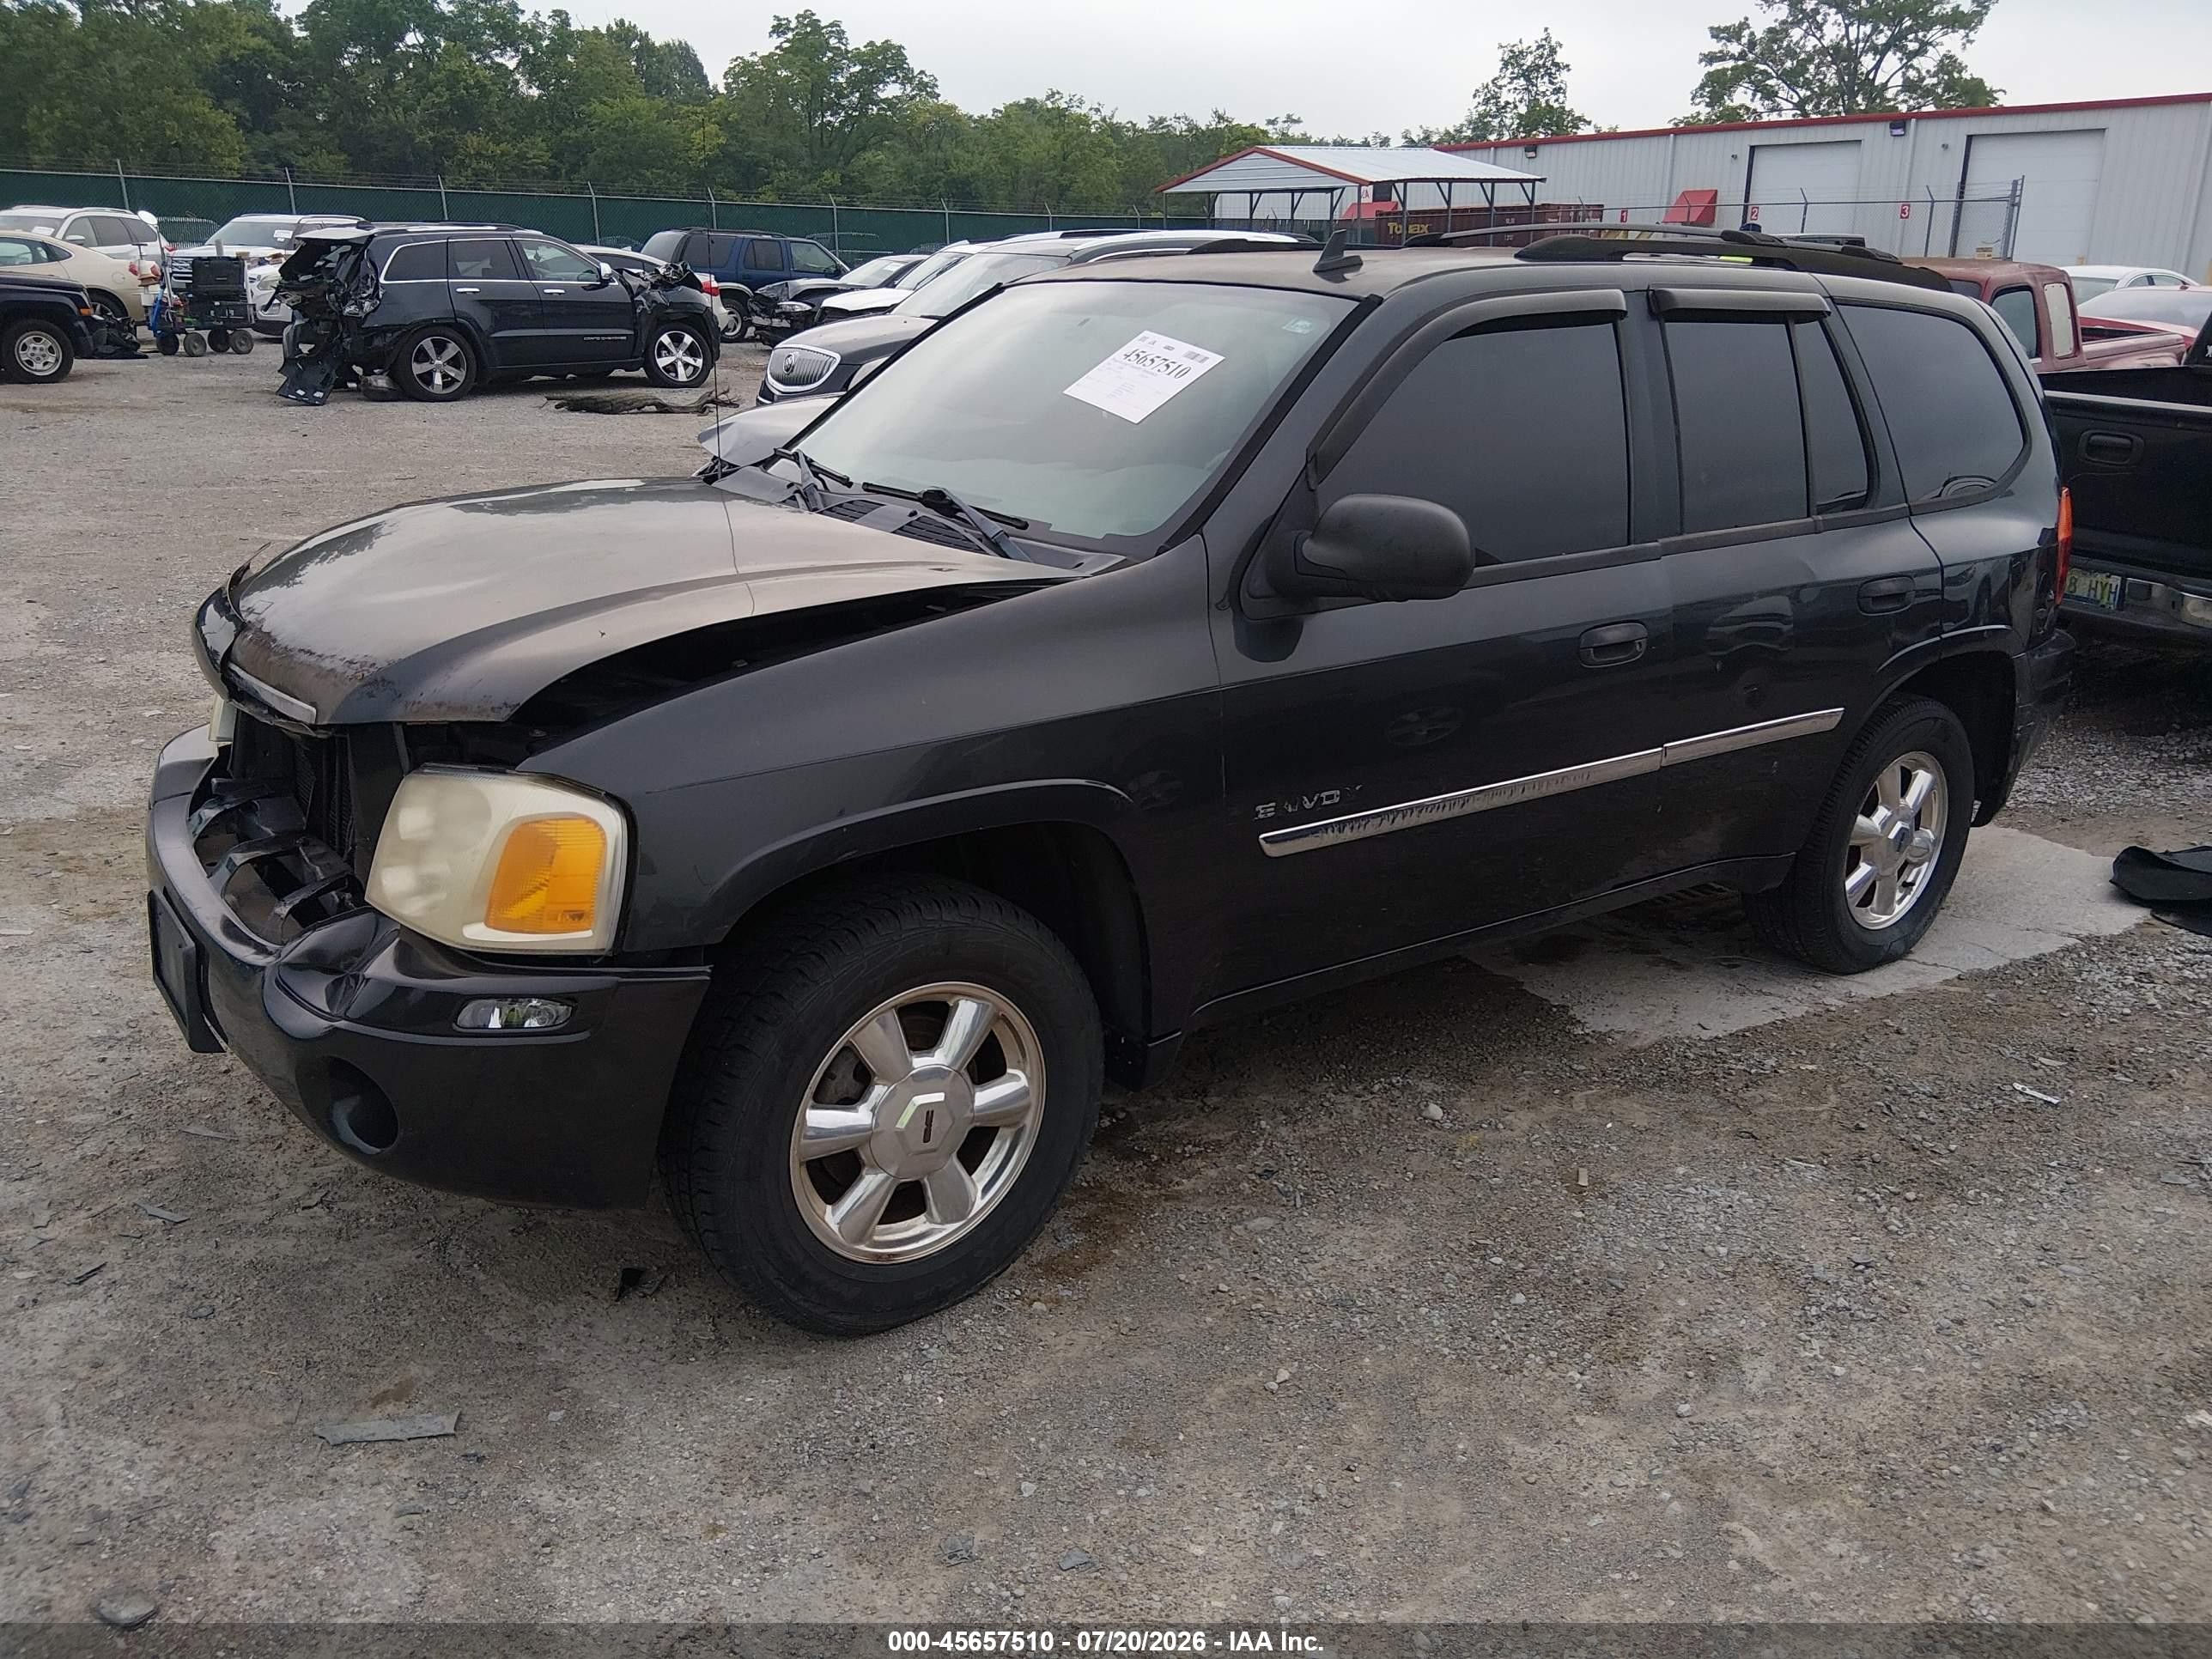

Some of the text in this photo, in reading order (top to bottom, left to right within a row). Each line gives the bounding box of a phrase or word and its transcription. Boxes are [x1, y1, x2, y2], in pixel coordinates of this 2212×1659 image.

[1621, 210, 1627, 222] 1
[1751, 208, 1759, 220] 2
[1901, 205, 1909, 218] 3
[1122, 349, 1192, 379] 45657510
